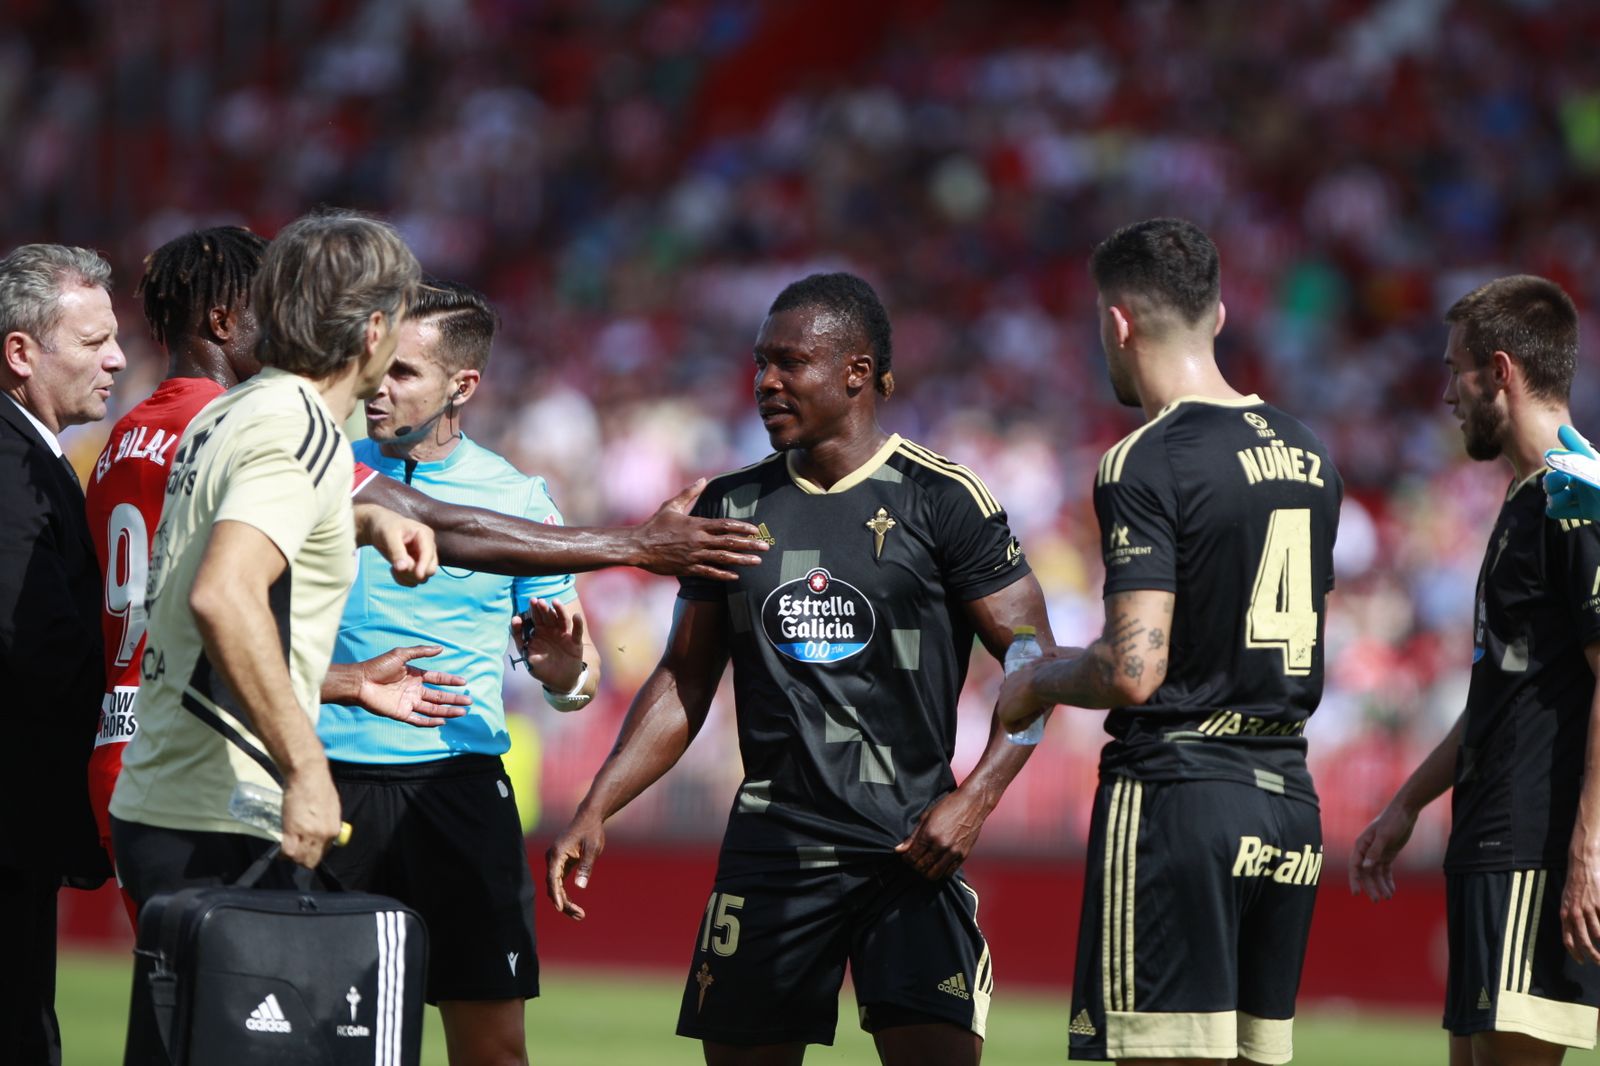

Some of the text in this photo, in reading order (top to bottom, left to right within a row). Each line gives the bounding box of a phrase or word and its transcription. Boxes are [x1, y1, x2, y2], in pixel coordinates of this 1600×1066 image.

[96, 426, 178, 484] EL BILAL
[1237, 439, 1325, 488] NUÑEZ
[105, 502, 148, 667] 9
[777, 594, 856, 617] Estrella
[1246, 508, 1318, 676] 4
[781, 616, 855, 639] Galicia
[701, 892, 745, 957] 15
[937, 983, 970, 1000] adidas
[245, 1017, 292, 1034] adidas
